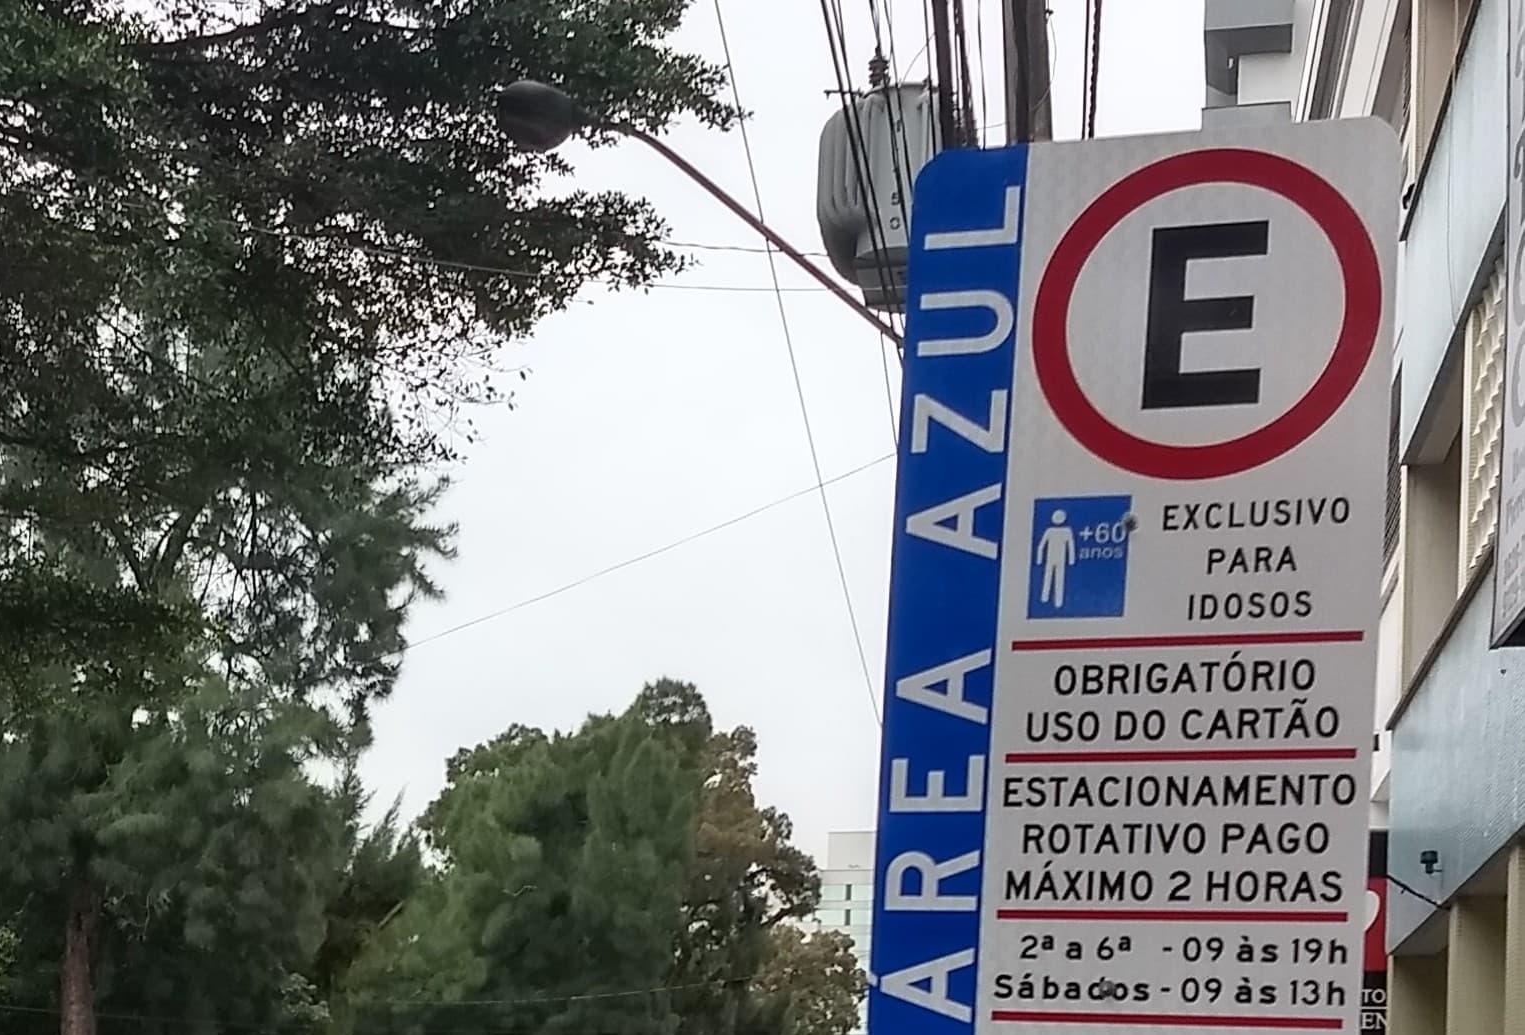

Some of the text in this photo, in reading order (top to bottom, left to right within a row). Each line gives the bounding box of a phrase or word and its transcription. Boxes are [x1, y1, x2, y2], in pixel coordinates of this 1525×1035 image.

[1141, 219, 1269, 411] E
[905, 185, 1022, 560] AZUL
[1162, 497, 1350, 531] EXCLUSIVO
[1079, 522, 1127, 544] +60
[1079, 547, 1123, 560] anos
[1206, 545, 1297, 575] PARA
[1187, 590, 1313, 621] IDOSOS
[1054, 650, 1316, 696] OBRIGATÓRIO
[1025, 697, 1340, 743] USO DO CARTÃO
[1002, 774, 1357, 808] ESTACIONAMENTO
[1022, 822, 1331, 855] ROTATIVO PAGO
[1005, 860, 1344, 903] MÁXIMO 2 HORAS
[1064, 940, 1083, 961] a
[1182, 936, 1225, 963] 09
[1235, 935, 1279, 964] às
[1290, 937, 1348, 965] 19h
[993, 972, 1151, 1002] Sábados
[1181, 976, 1223, 1004] 09
[1233, 976, 1278, 1005] às
[1288, 979, 1347, 1007] 13h
